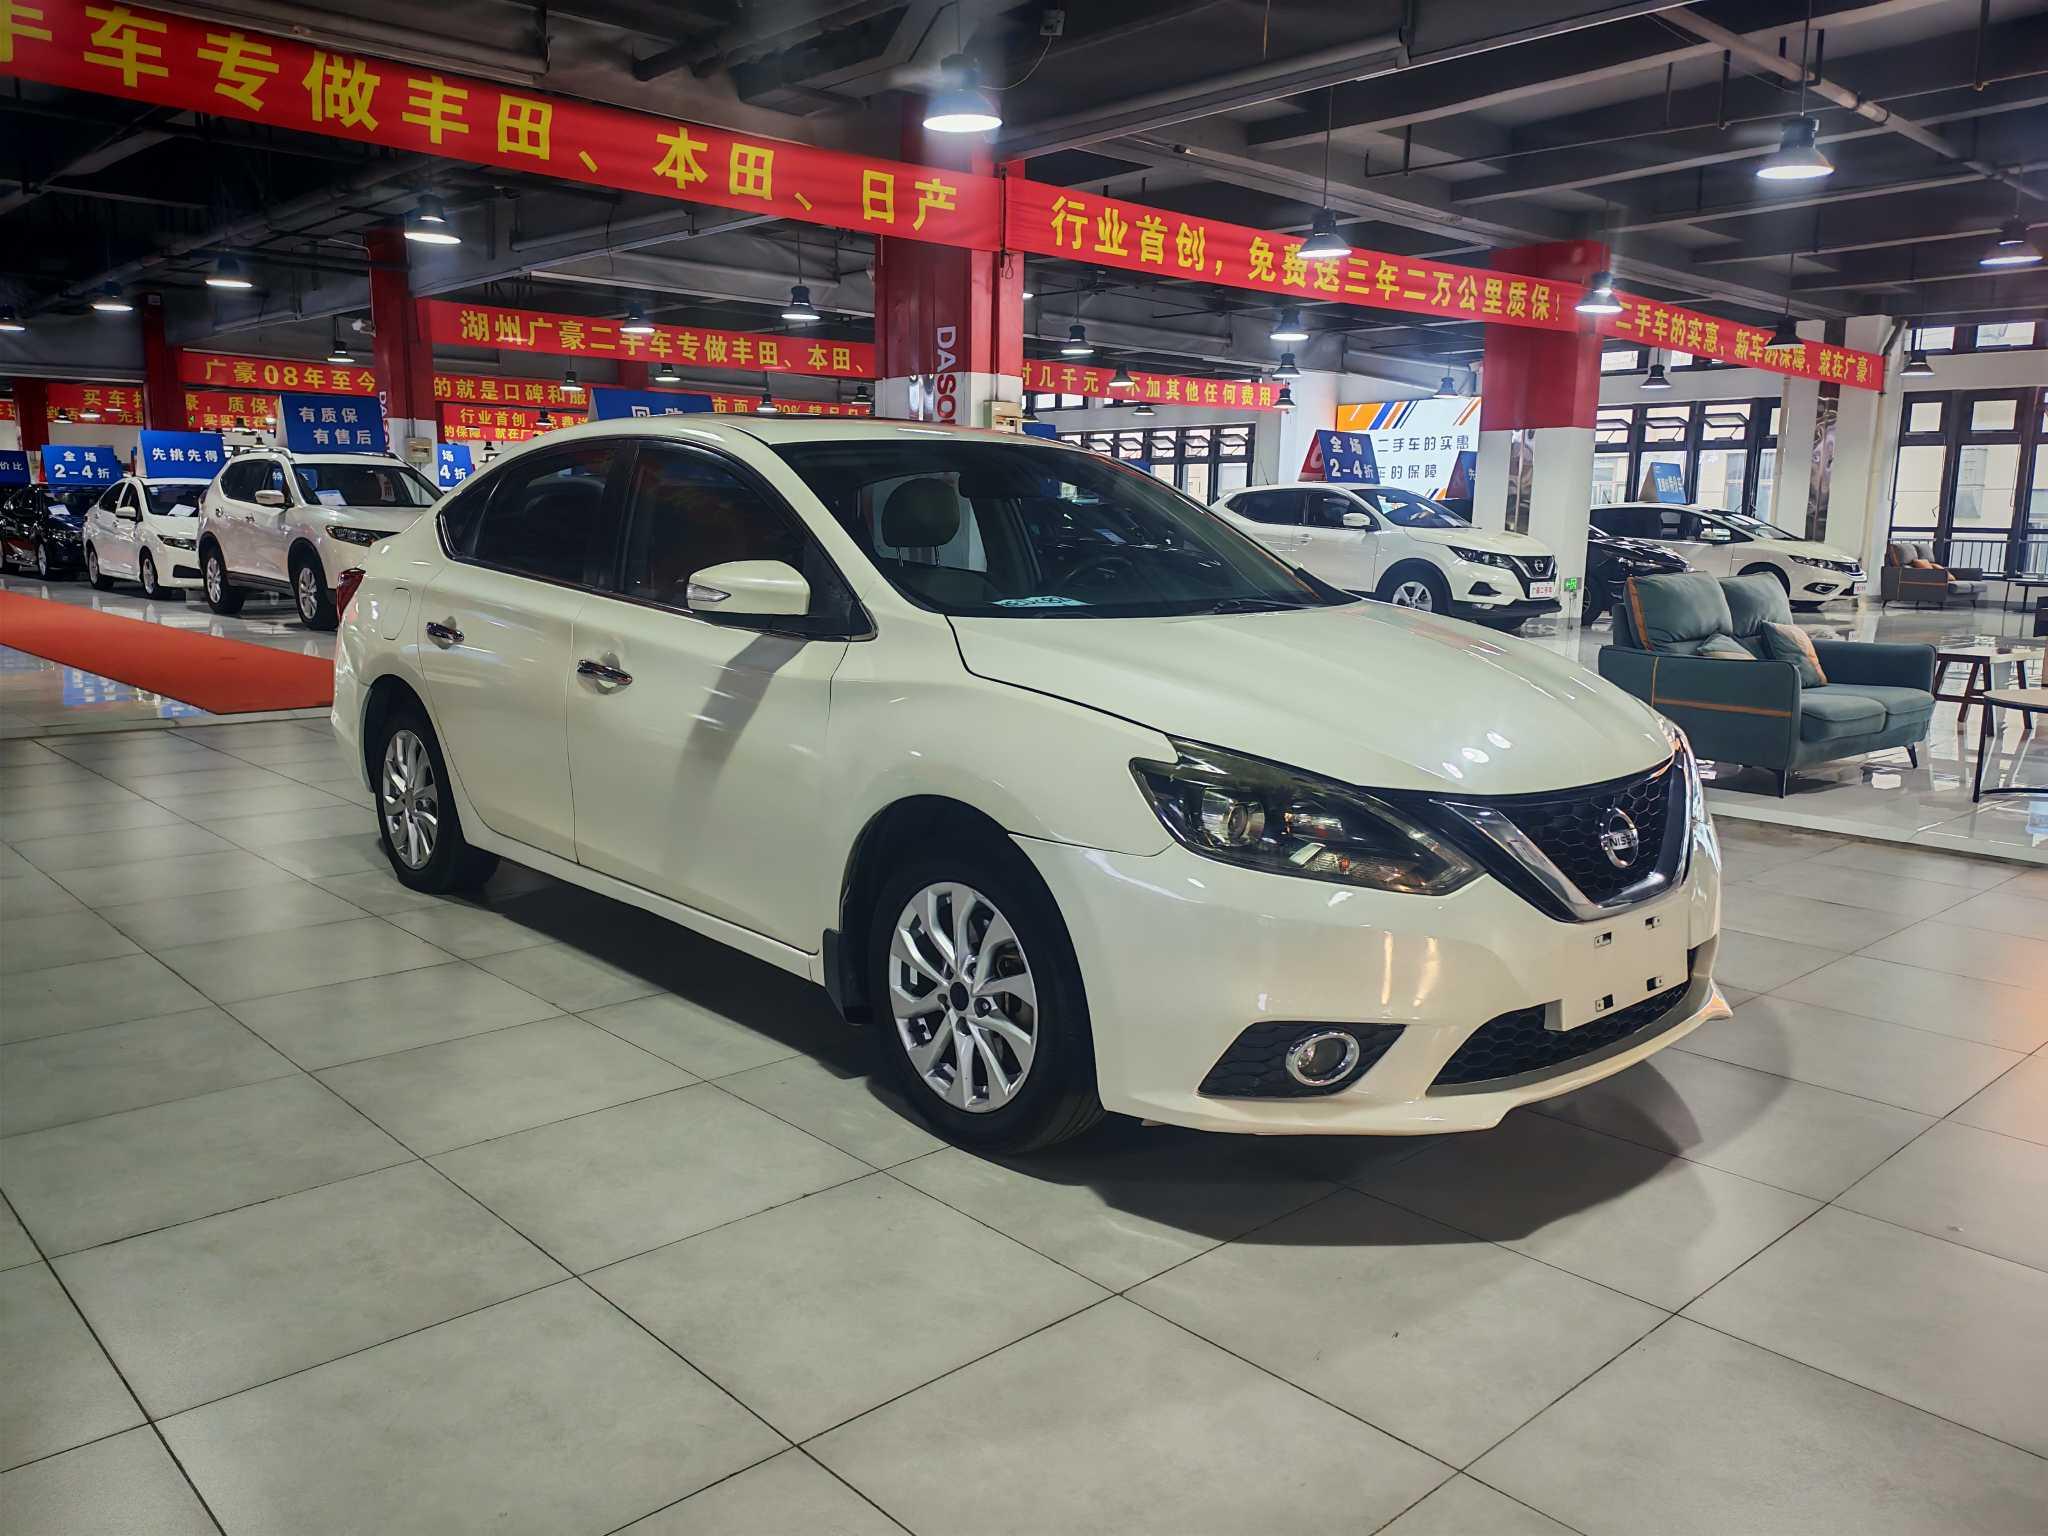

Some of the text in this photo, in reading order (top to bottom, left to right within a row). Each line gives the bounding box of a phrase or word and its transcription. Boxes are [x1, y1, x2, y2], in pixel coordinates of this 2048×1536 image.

[936, 326, 957, 424] DASO
[299, 406, 358, 424] 有质保
[313, 428, 371, 445] 有售后
[1330, 435, 1363, 455] 全场
[1377, 434, 1469, 453] 二手车的实惠
[63, 451, 97, 462] 全场
[152, 448, 218, 463] 先挑先得
[54, 464, 110, 479] 2-4折
[1329, 458, 1374, 480] 2-4折
